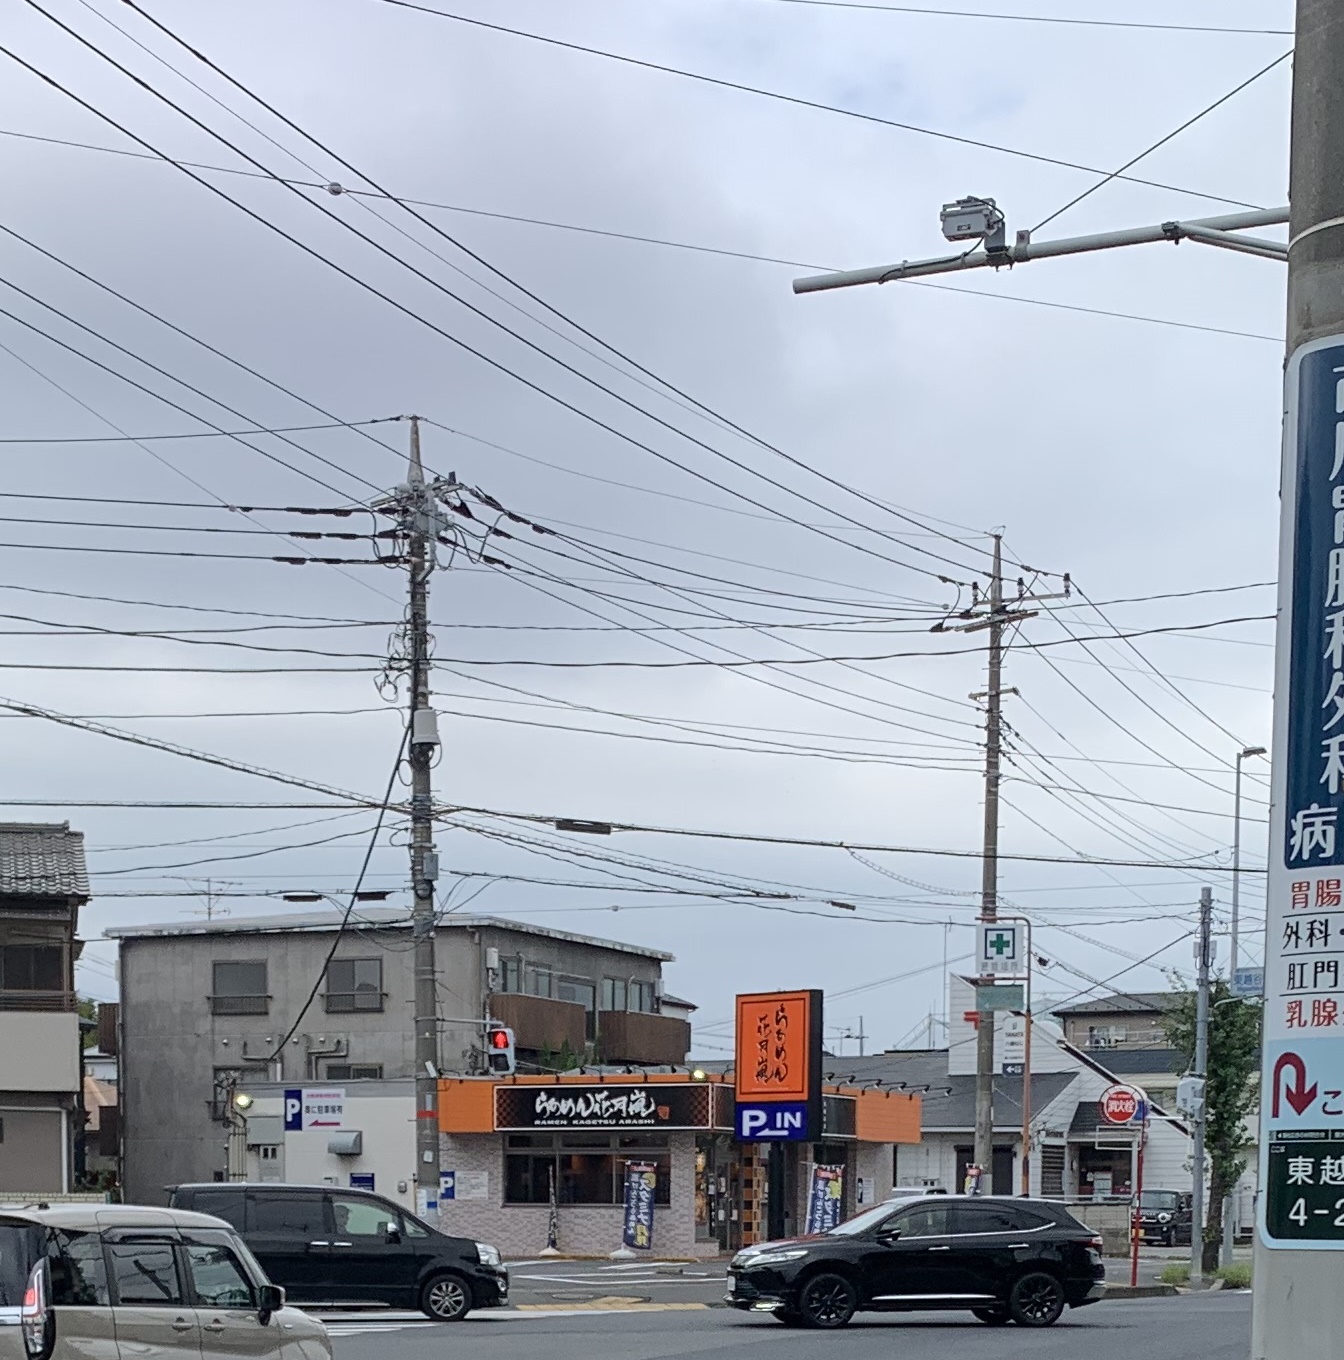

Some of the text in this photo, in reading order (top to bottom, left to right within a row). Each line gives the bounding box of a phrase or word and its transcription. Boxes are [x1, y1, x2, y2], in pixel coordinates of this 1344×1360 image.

[286, 1098, 300, 1122] P
[1107, 1099, 1135, 1113] 消火栓
[742, 1109, 802, 1137] P IN
